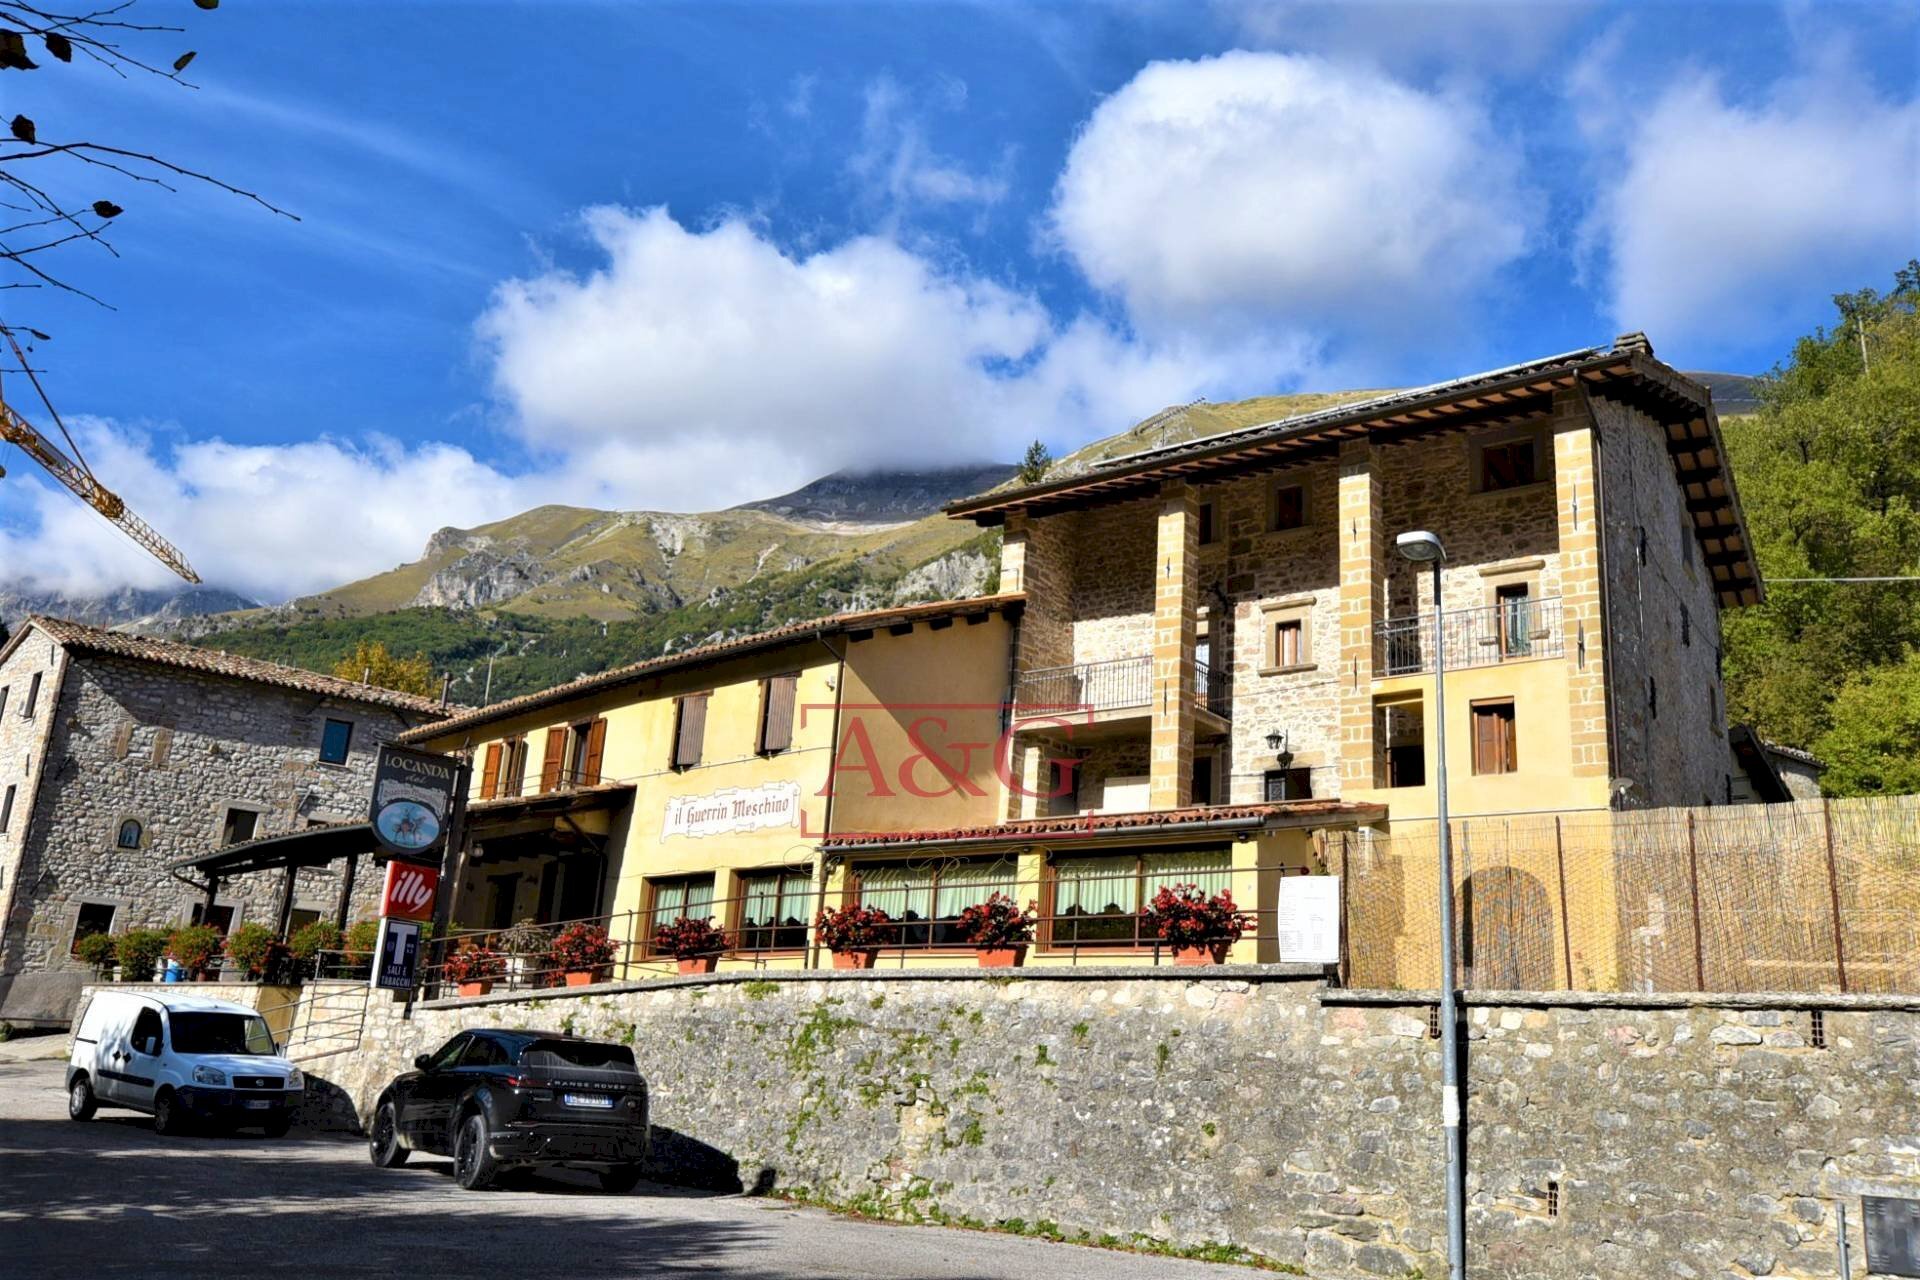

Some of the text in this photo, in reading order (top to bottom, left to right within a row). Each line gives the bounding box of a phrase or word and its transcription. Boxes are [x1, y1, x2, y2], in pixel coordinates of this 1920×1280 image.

[384, 754, 450, 779] LOCANDA
[674, 795, 789, 828] il Guerrin Meschino
[390, 871, 433, 913] illy
[389, 922, 418, 965] T
